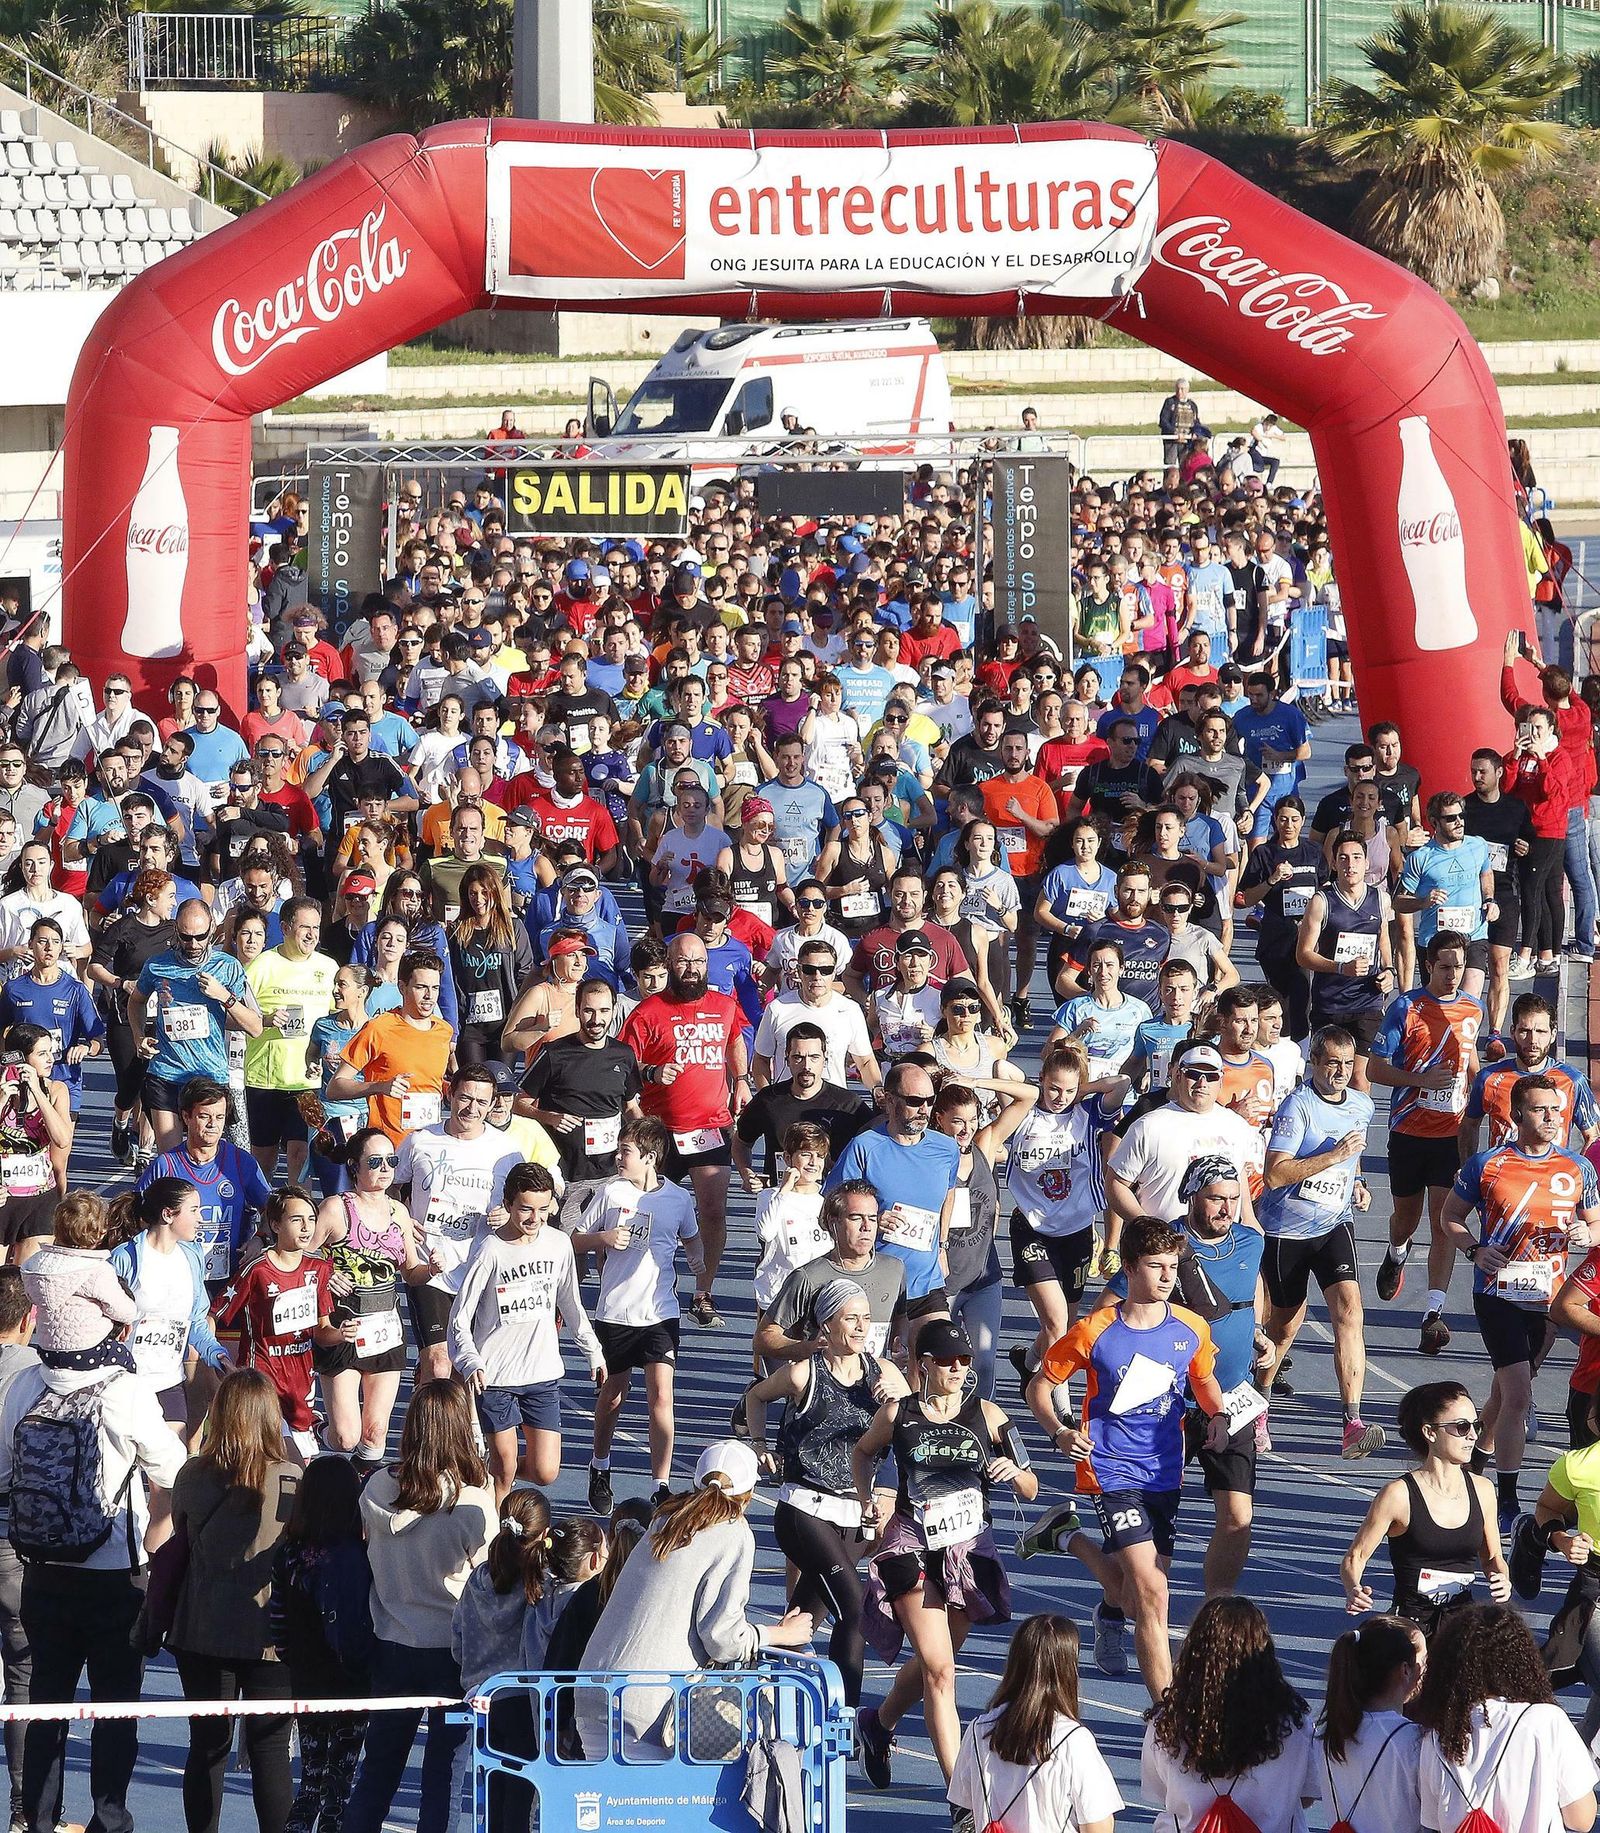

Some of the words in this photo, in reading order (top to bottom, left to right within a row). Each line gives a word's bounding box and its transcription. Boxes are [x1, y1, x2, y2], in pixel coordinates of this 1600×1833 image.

[710, 166, 1137, 236] entreculturas
[710, 258, 746, 271] ONG
[752, 257, 816, 271] JESUITA
[820, 257, 860, 271] PARA
[865, 257, 885, 270] LA
[890, 252, 985, 270] EDUCACIÓN
[991, 255, 1000, 268] Y
[1006, 255, 1024, 267] EL
[1030, 250, 1135, 267] DESARROLLO
[512, 470, 689, 516] SALIDA
[1006, 468, 1015, 526] deportivos
[320, 475, 331, 534] deportivos
[1016, 464, 1038, 557] Tempo
[331, 473, 354, 567] Tempo
[320, 537, 331, 575] eventos
[1006, 529, 1015, 568] eventos
[1006, 570, 1015, 588] de
[852, 901, 871, 911] 233
[1448, 917, 1466, 928] 322
[1344, 945, 1368, 957] 4344
[175, 1020, 196, 1032] 381
[673, 1023, 725, 1041] CORRE
[675, 1046, 724, 1065] CAUSA
[1432, 1089, 1453, 1103] 139
[419, 1107, 433, 1121] 36
[603, 1131, 616, 1145] 35
[691, 1135, 706, 1146] 56
[1030, 1147, 1061, 1161] 4574
[12, 1165, 40, 1178] 4487
[440, 1171, 495, 1192] jesuitas
[1313, 1180, 1341, 1196] 4557
[437, 1212, 470, 1232] 4465
[902, 1222, 924, 1241] 261
[501, 1260, 555, 1284] HACKETT
[1513, 1277, 1538, 1292] 122
[283, 1303, 311, 1321] 4138
[511, 1295, 544, 1313] 4434
[144, 1332, 176, 1346] 4248
[374, 1329, 388, 1344] 23
[937, 1509, 973, 1533] 4172
[1112, 1508, 1143, 1532] 26
[606, 1796, 674, 1807] Ayuntamiento
[677, 1796, 689, 1805] de
[692, 1794, 728, 1805] Málaga
[606, 1817, 624, 1826] Área
[625, 1818, 635, 1826] de
[637, 1817, 666, 1827] Deporte
